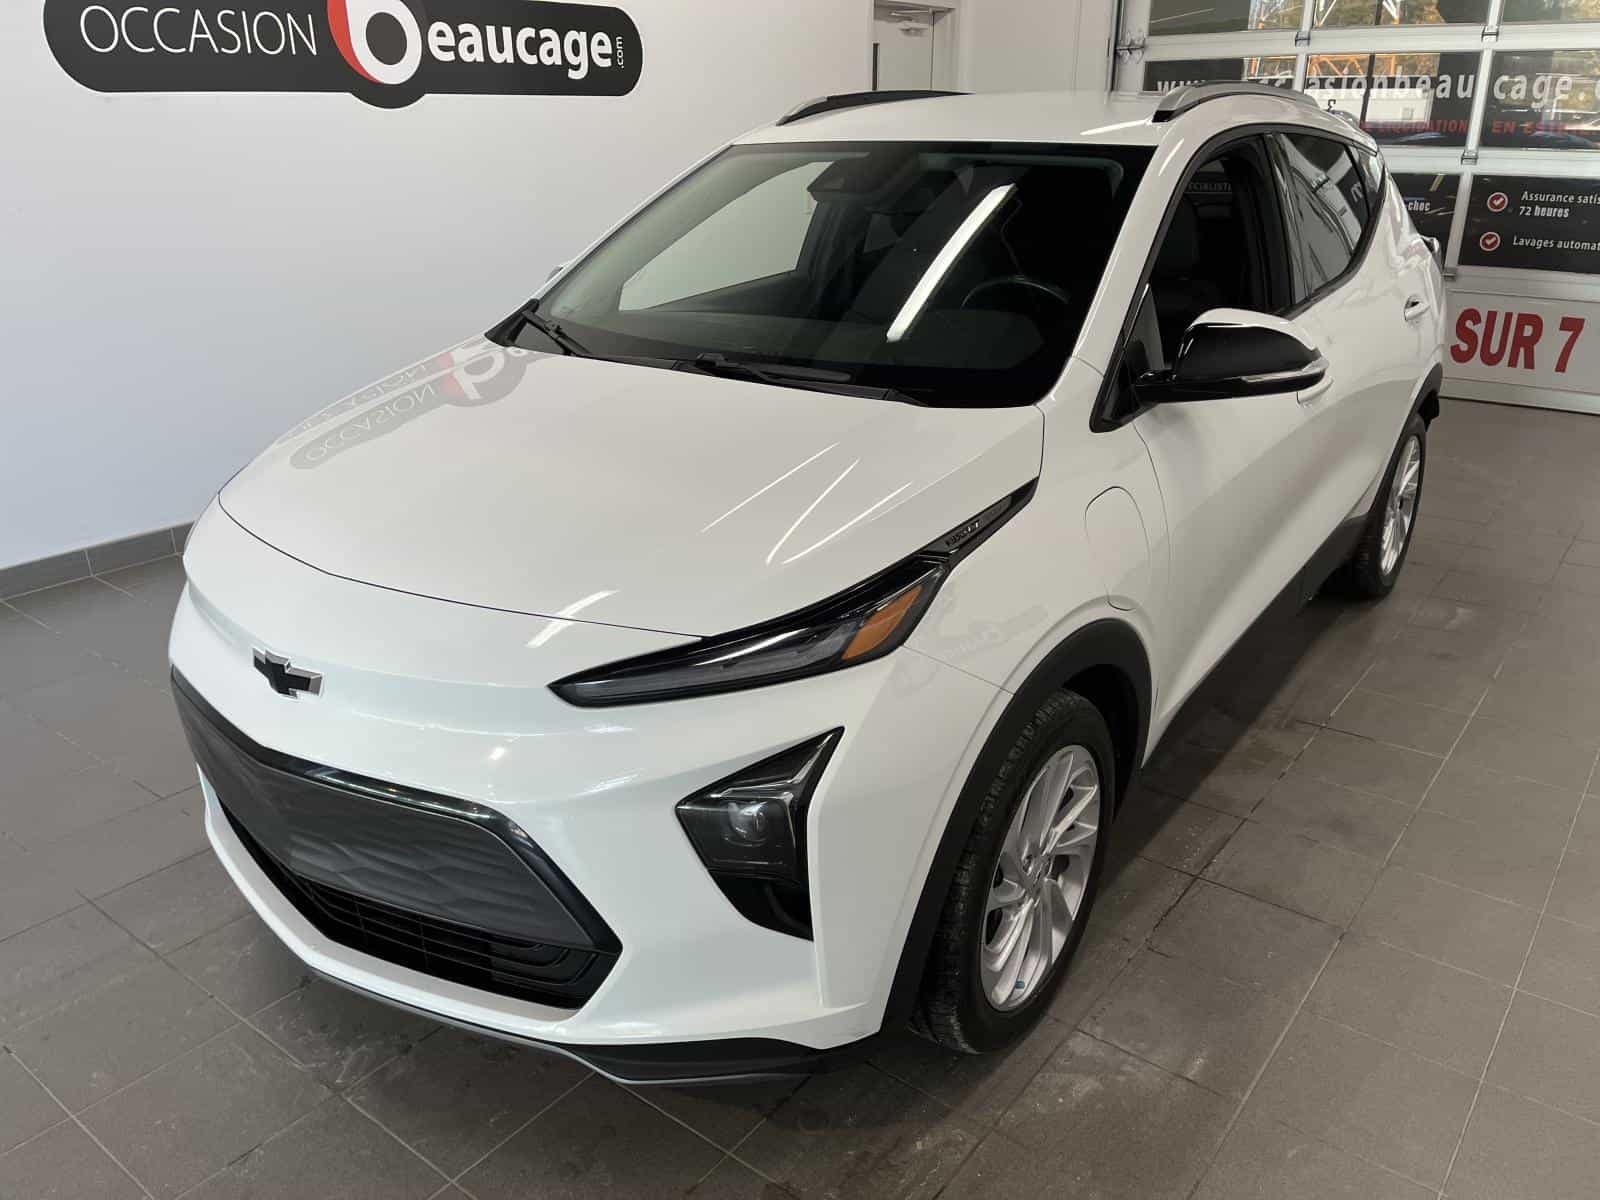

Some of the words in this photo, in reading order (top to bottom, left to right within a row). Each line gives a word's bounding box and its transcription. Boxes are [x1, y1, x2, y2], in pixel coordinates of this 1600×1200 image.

[80, 5, 318, 56] OCCASION
[617, 36, 625, 69] .com
[1522, 191, 1574, 203] Assurance
[1520, 206, 1531, 216] 72
[1534, 206, 1569, 218] heures
[1513, 235, 1554, 249] Lavages
[1450, 308, 1544, 370] SUR
[1554, 316, 1585, 373] 7
